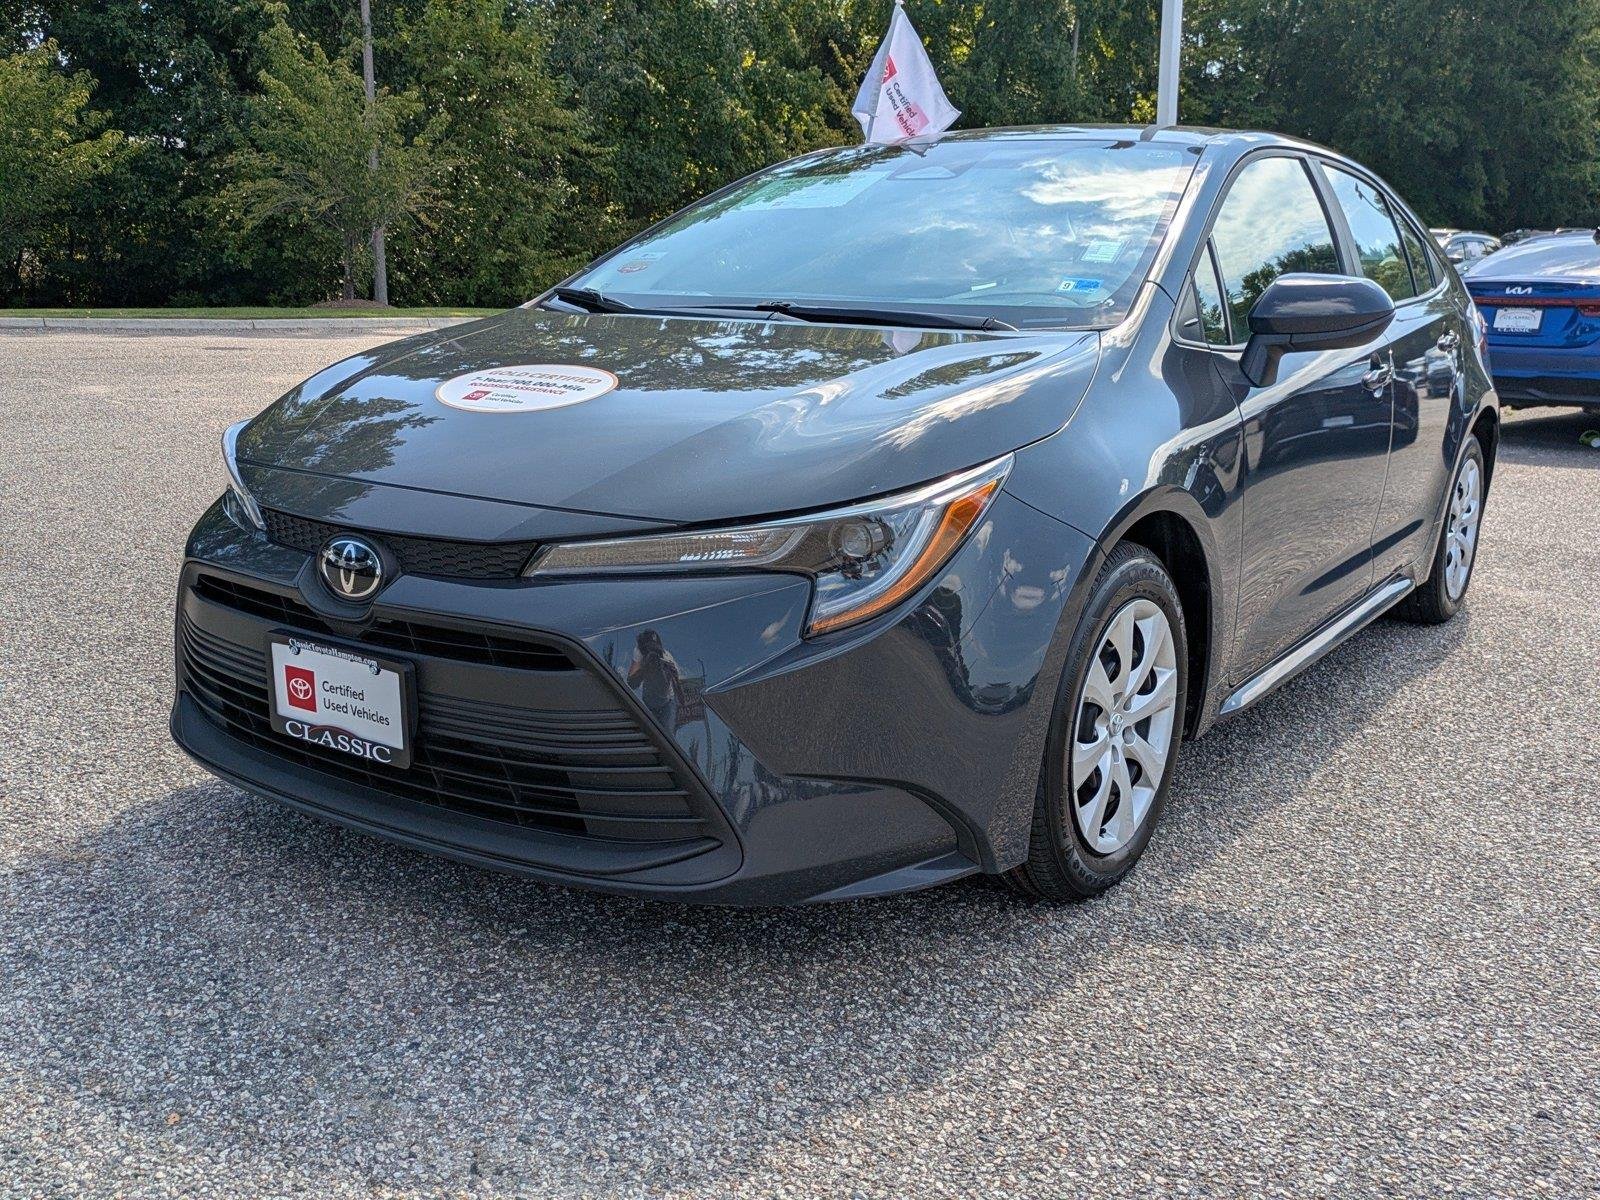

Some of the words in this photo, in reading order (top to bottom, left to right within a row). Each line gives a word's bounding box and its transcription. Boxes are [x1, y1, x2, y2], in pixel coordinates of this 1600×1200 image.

[886, 87, 900, 111] Used
[893, 82, 917, 119] Certified
[1505, 286, 1532, 295] KIA
[529, 372, 602, 385] CERTIFIED
[322, 680, 365, 702] Certified
[323, 698, 349, 715] Used
[350, 704, 390, 726] Vehicles
[285, 720, 392, 763] CLASSIC
